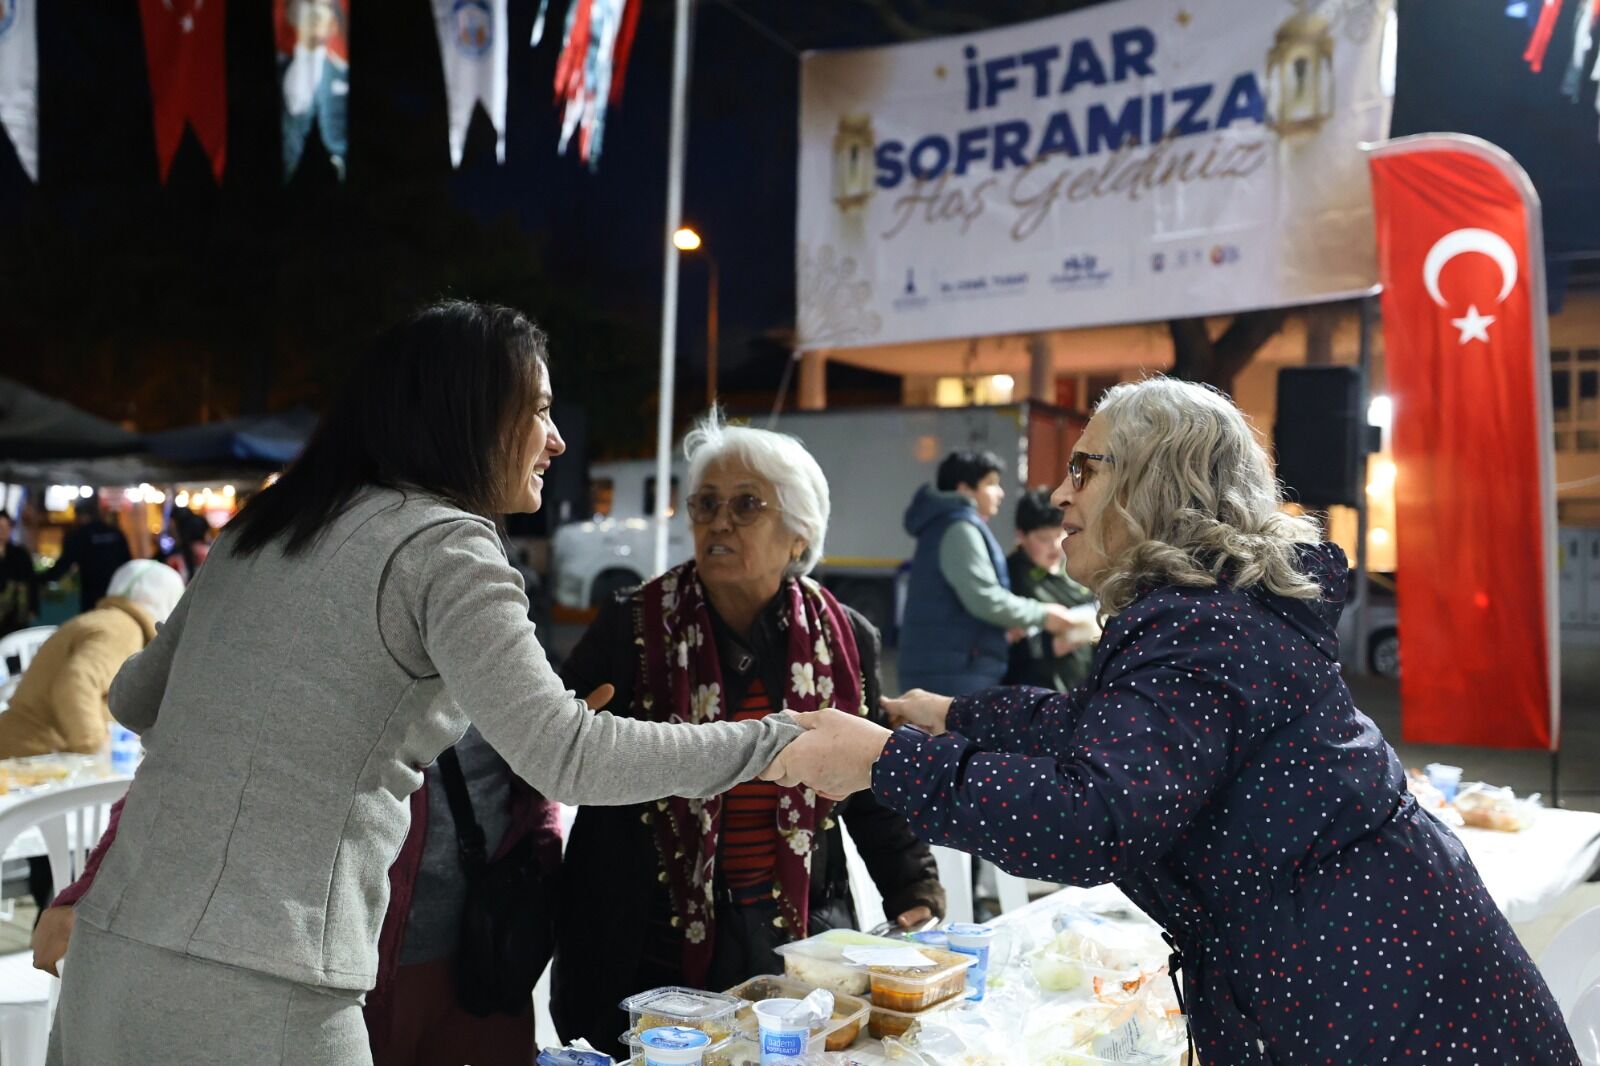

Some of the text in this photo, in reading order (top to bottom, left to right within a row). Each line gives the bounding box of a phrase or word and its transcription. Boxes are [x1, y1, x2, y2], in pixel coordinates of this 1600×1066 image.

[963, 26, 1157, 112] İFTAR
[874, 71, 1267, 190] SOFRAMIZA
[881, 128, 1266, 241] Hoş Geldiniz
